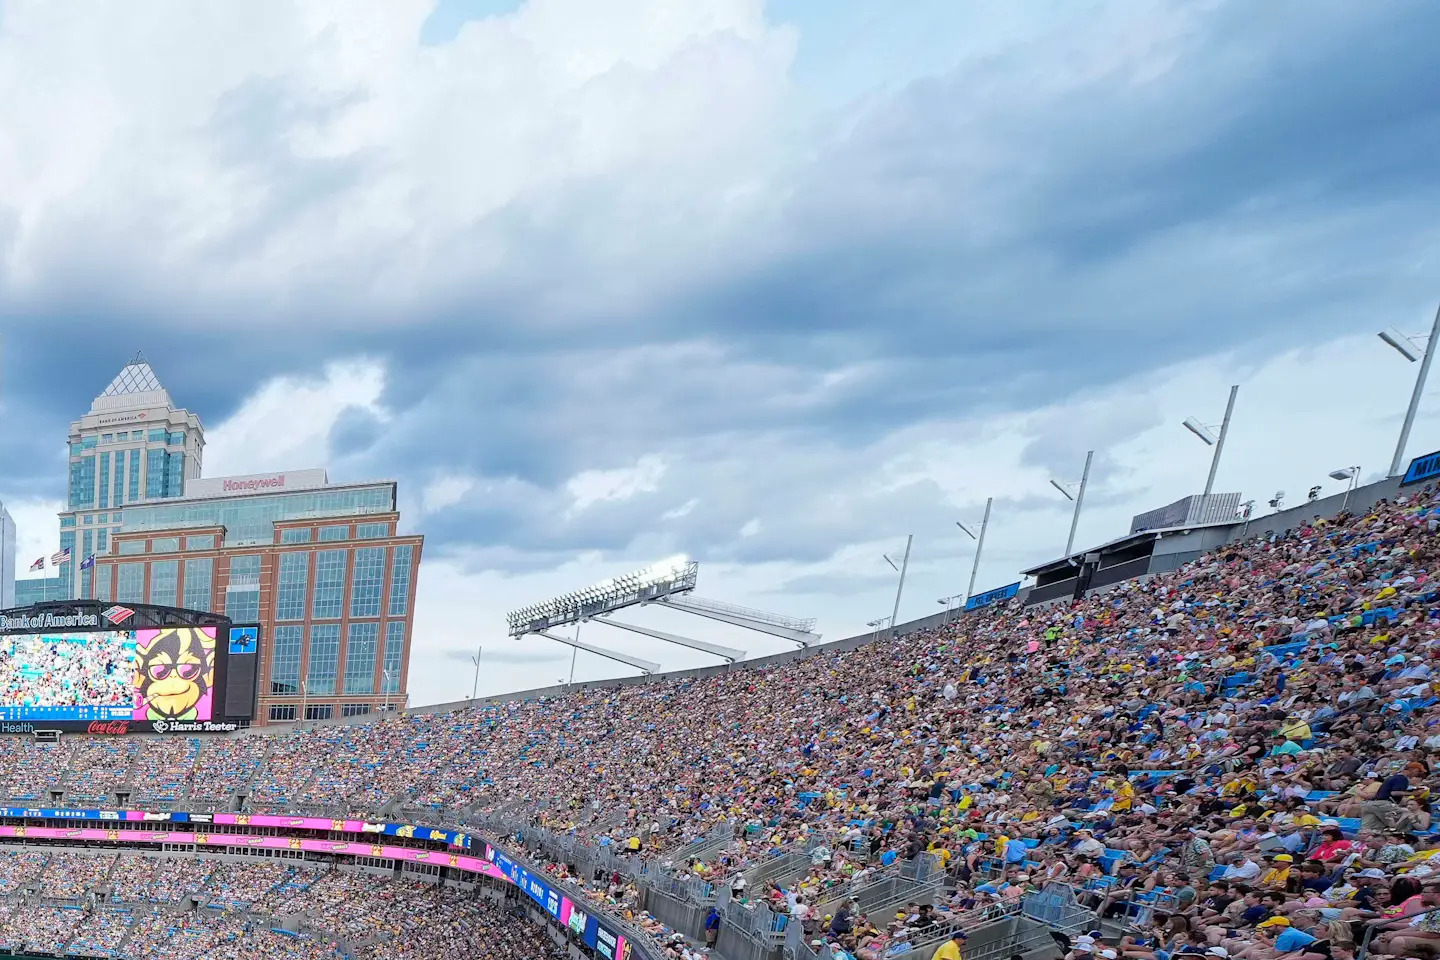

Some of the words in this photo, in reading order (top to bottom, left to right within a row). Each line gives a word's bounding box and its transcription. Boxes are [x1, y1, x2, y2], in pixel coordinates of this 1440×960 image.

[223, 475, 285, 492] Honeywell
[30, 613, 44, 627] of
[44, 611, 97, 627] America
[1, 722, 34, 733] Health
[169, 722, 202, 732] Harris
[202, 721, 237, 732] Teeter
